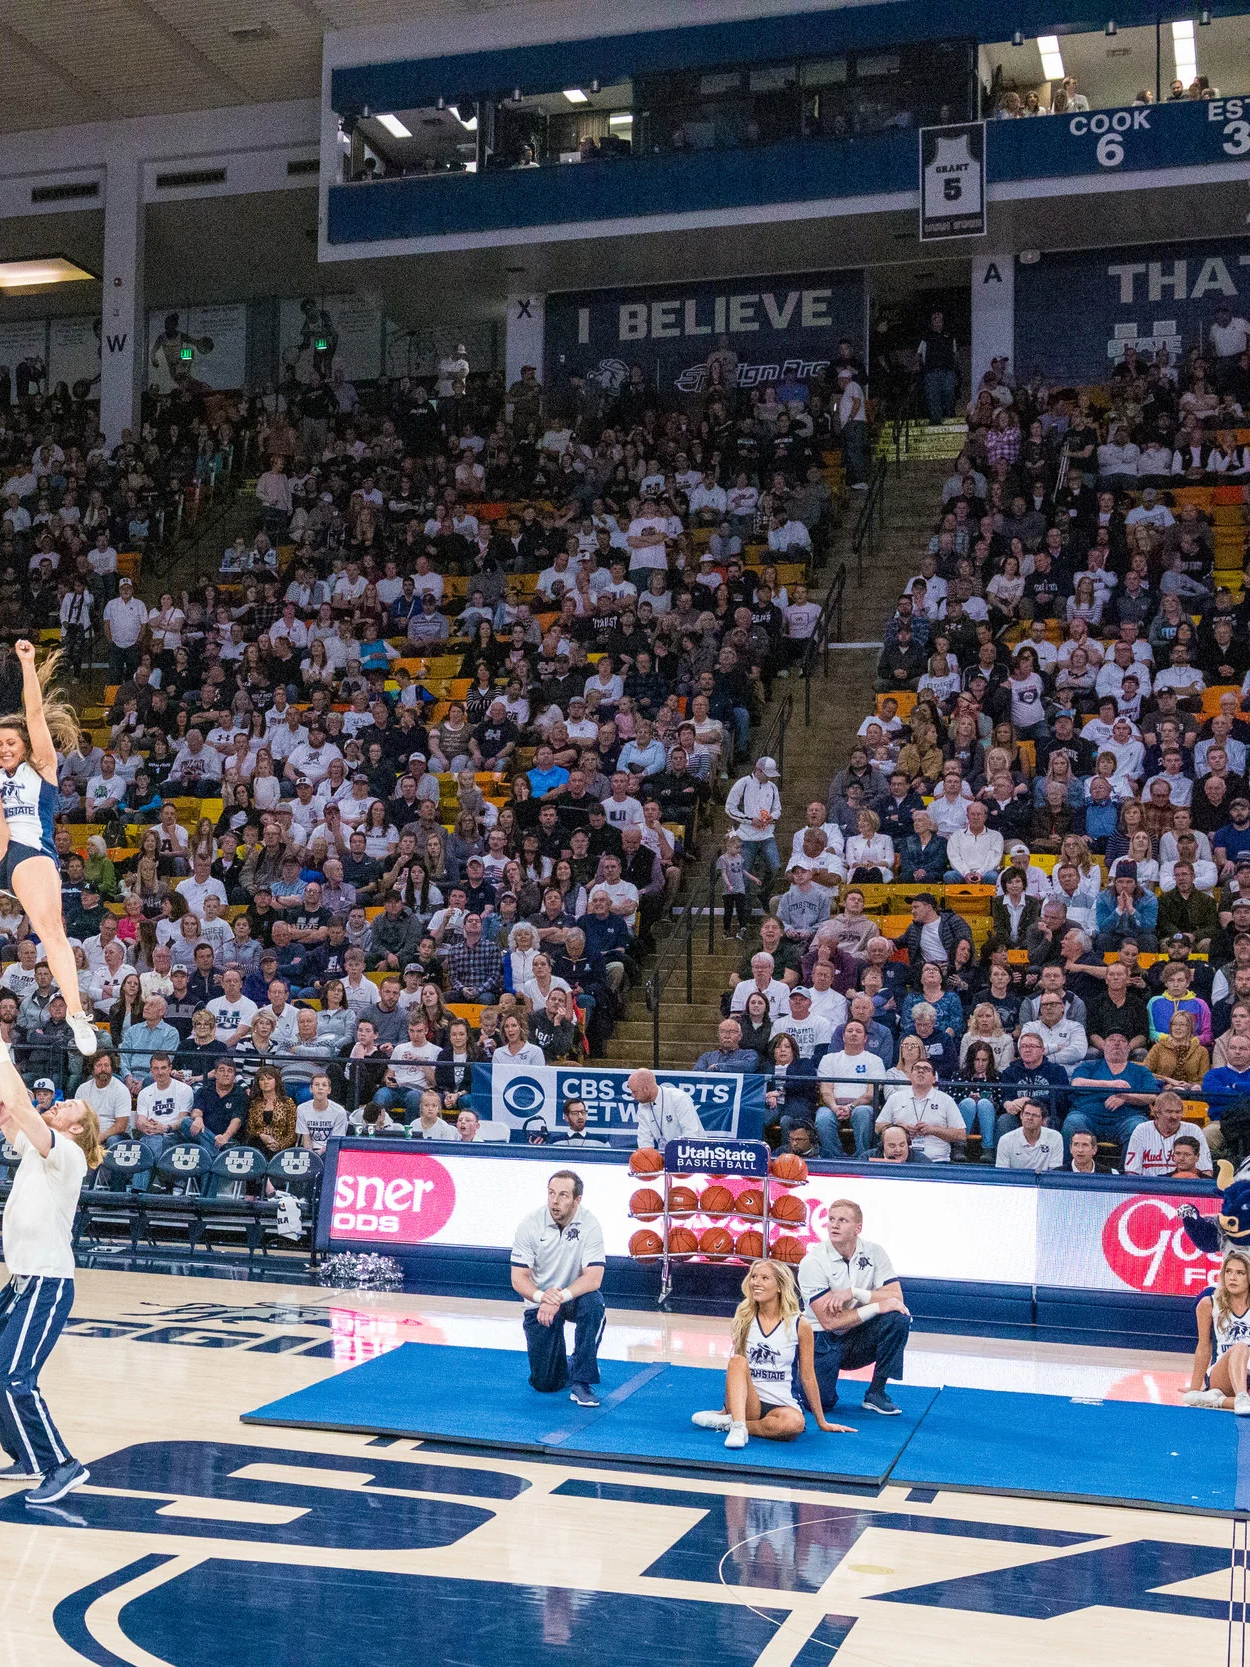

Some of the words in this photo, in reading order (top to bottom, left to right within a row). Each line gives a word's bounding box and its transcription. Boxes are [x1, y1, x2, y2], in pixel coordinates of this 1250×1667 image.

[1069, 108, 1151, 136] COOK
[1223, 120, 1250, 155] 3
[1096, 134, 1124, 167] 6
[936, 163, 969, 174] GRANT
[943, 177, 961, 201] 5
[983, 263, 1002, 284] A
[517, 299, 532, 319] X
[578, 308, 589, 344] I
[618, 289, 833, 342] BELIEVE
[106, 334, 127, 352] W
[8, 806, 35, 817] STATE
[215, 1016, 241, 1024] STATE
[562, 1078, 615, 1100] CBS
[621, 1081, 730, 1104] SRTS
[152, 1102, 175, 1111] STATE
[113, 1150, 141, 1159] STATE
[171, 1154, 200, 1162] STATE
[225, 1158, 254, 1166] STATE
[677, 1145, 756, 1162] UtahState
[1126, 1152, 1135, 1166] 7
[1142, 1150, 1163, 1163] Mud
[281, 1158, 311, 1167] STATE
[677, 1158, 757, 1170] BASKETBALL
[335, 1175, 435, 1212] sner
[333, 1213, 400, 1232] ODS
